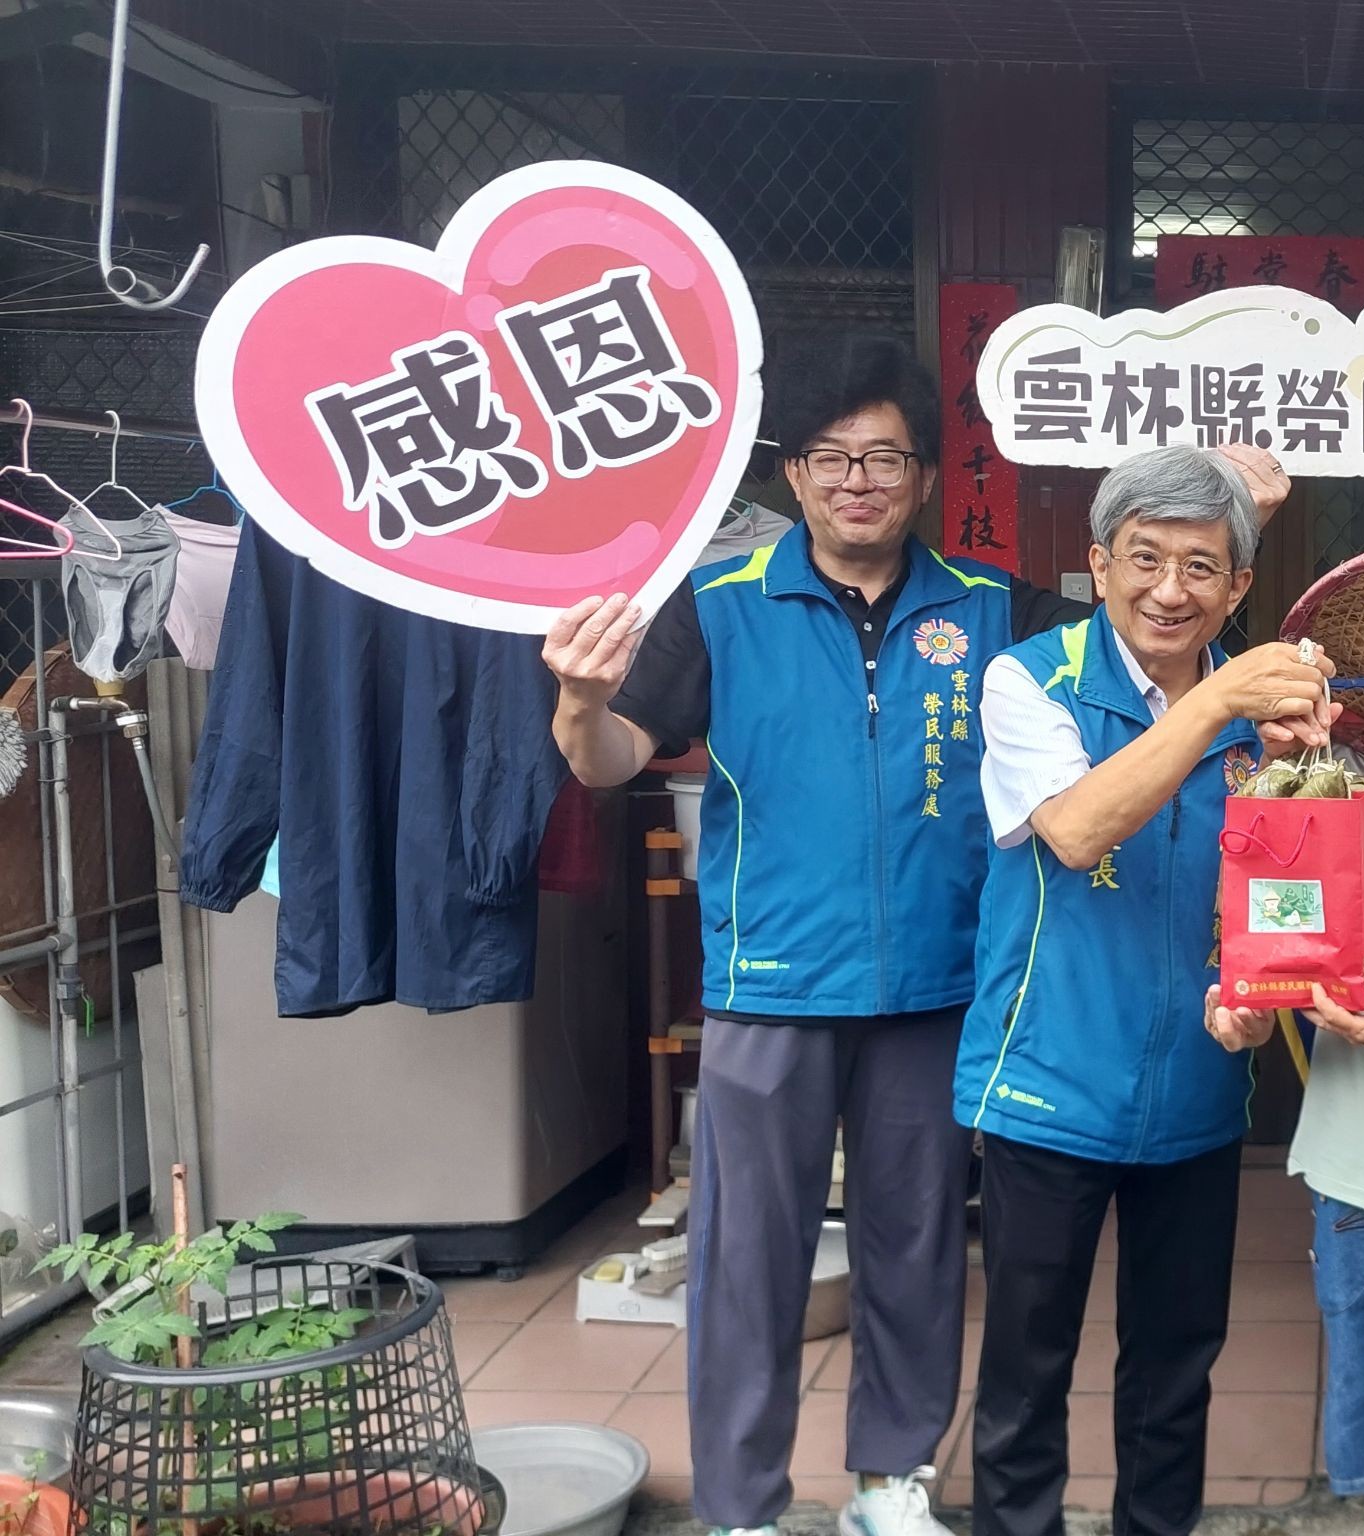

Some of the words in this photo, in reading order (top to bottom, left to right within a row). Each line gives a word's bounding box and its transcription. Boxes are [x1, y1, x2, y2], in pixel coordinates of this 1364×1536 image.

[316, 271, 713, 543] 感恩
[921, 692, 945, 818] 榮民服務處
[950, 669, 973, 741] 雲林縣
